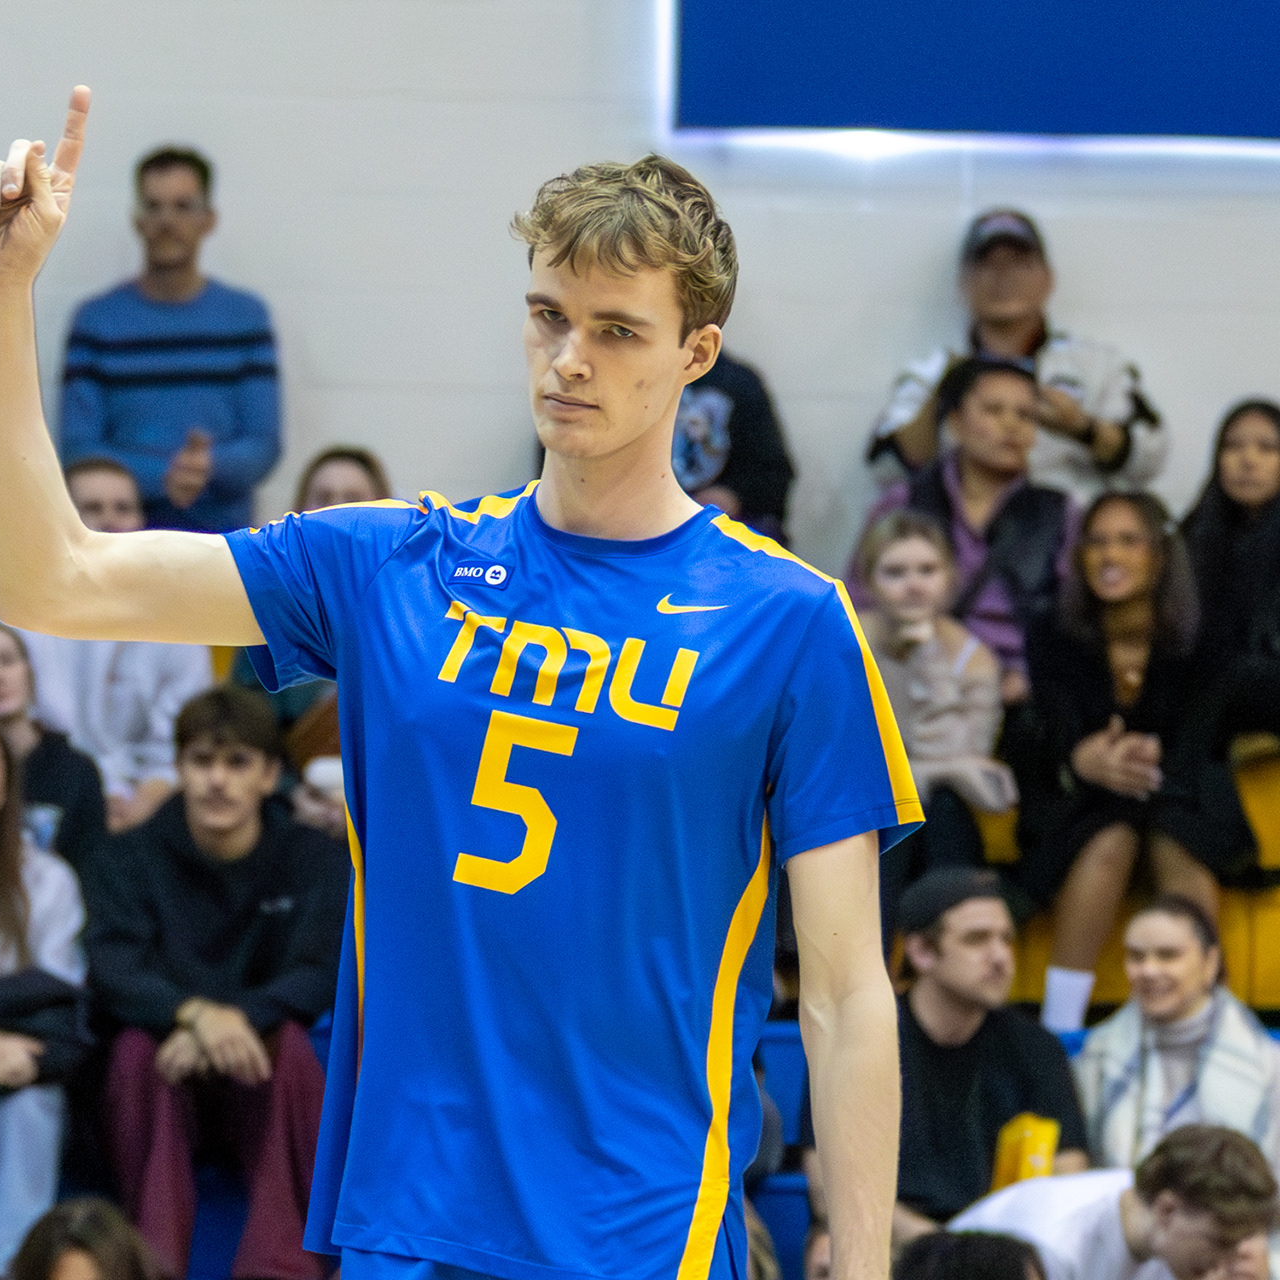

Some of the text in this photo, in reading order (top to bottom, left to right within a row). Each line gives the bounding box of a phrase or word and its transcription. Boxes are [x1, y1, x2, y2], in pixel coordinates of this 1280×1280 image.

[453, 566, 484, 578] BMO
[437, 600, 700, 732] TMU
[452, 709, 579, 895] 5
